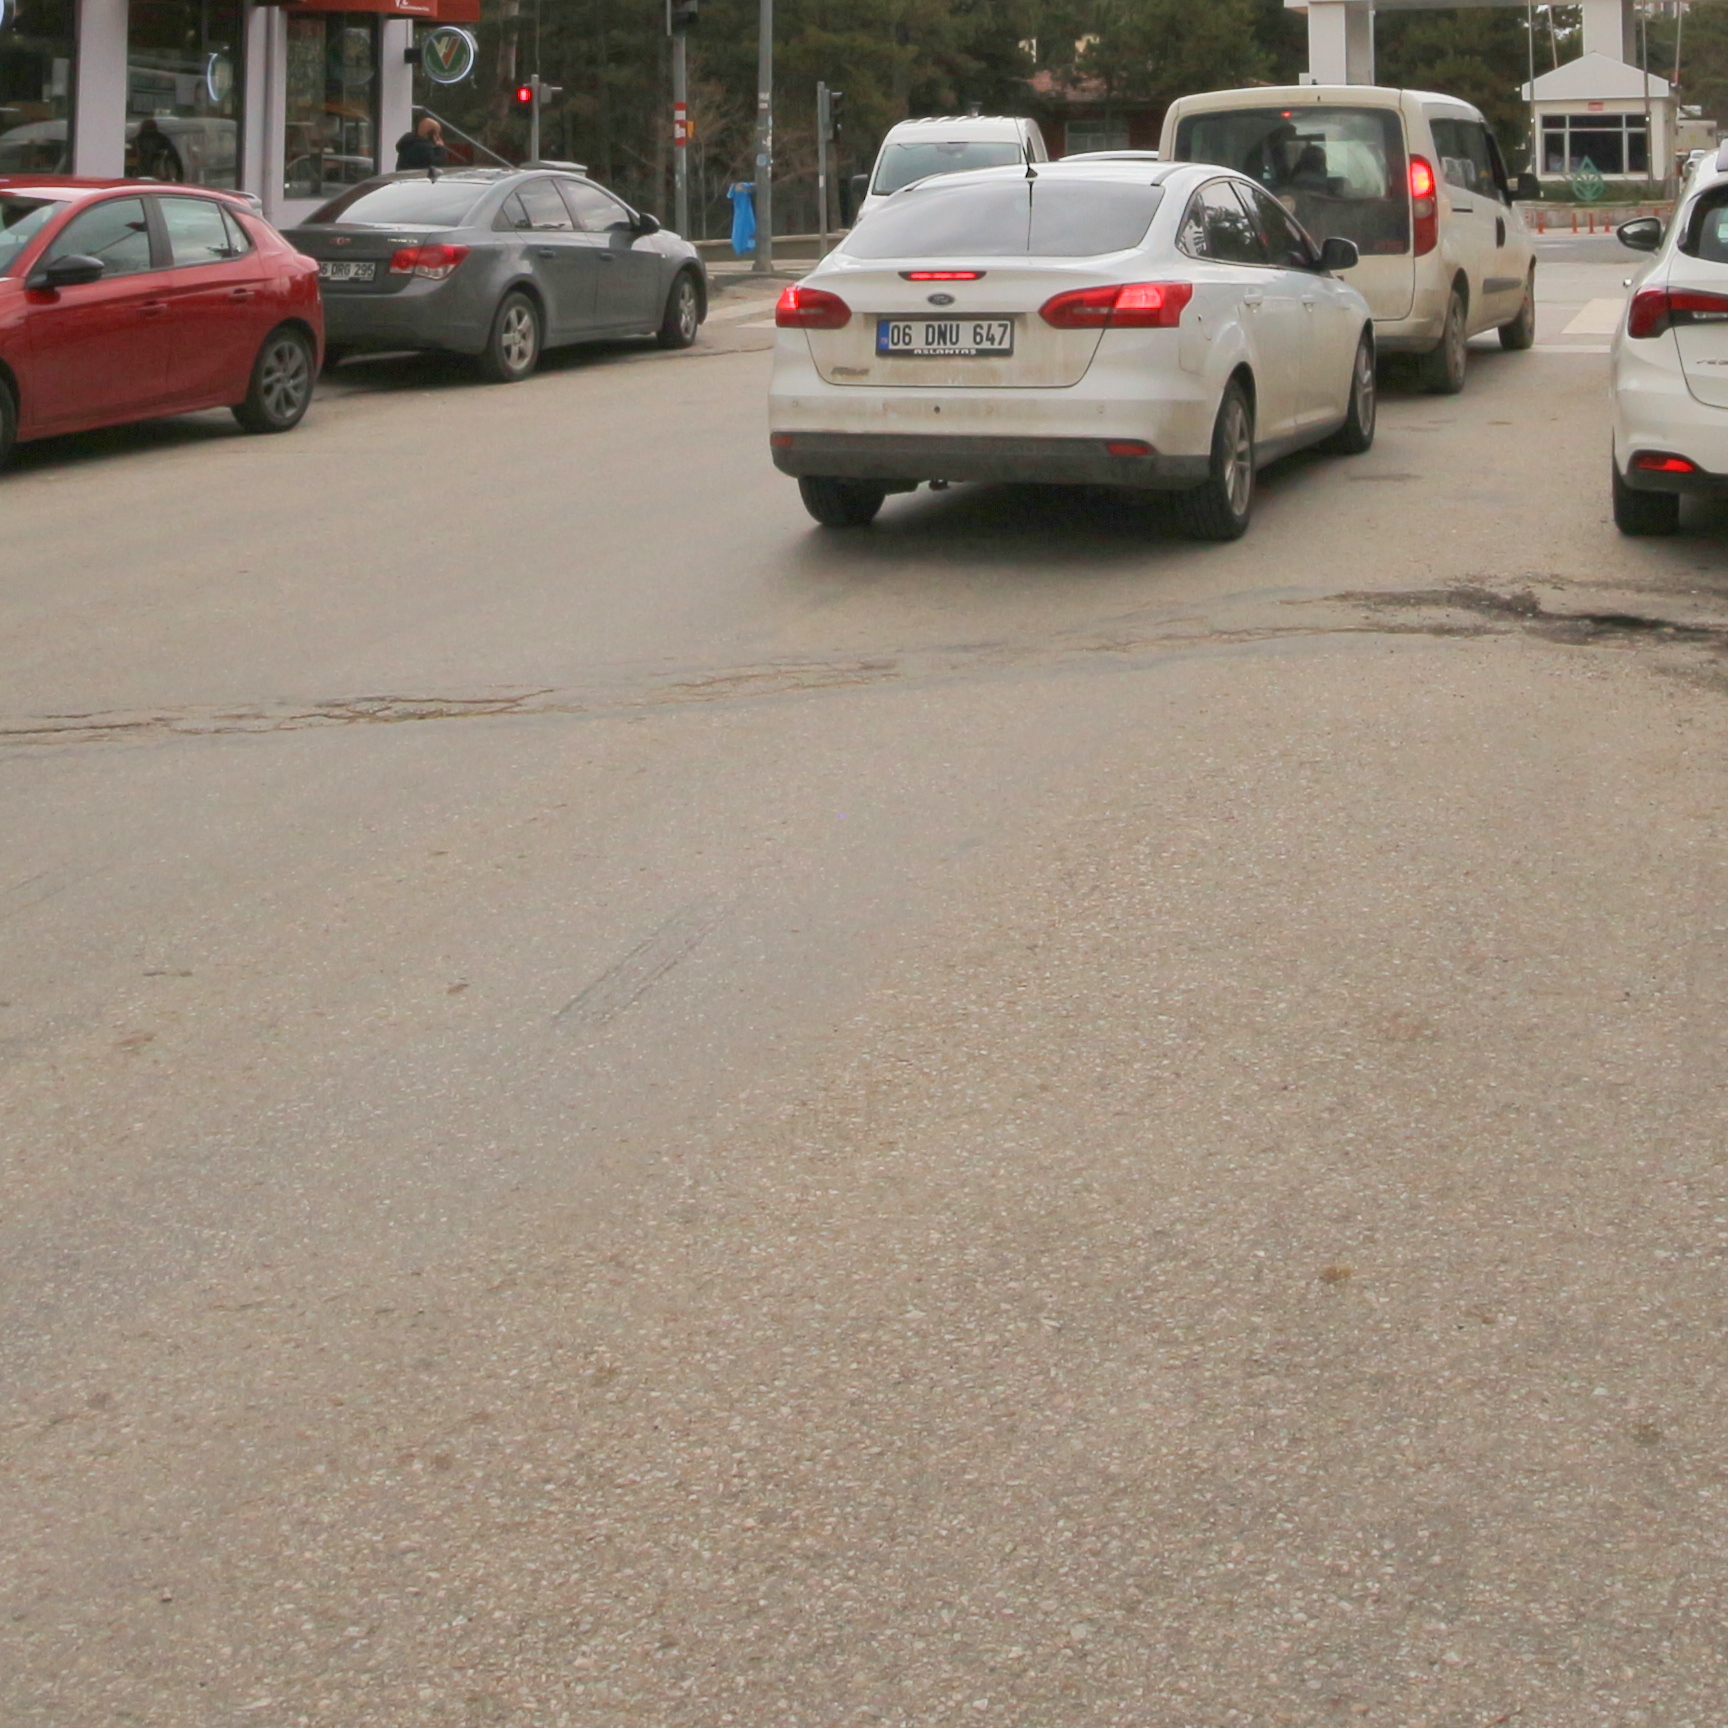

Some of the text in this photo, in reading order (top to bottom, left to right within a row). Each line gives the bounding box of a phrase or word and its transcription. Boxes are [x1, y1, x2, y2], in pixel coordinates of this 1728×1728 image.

[891, 324, 913, 346] 06
[925, 323, 960, 346] DNU
[973, 323, 1009, 346] 647
